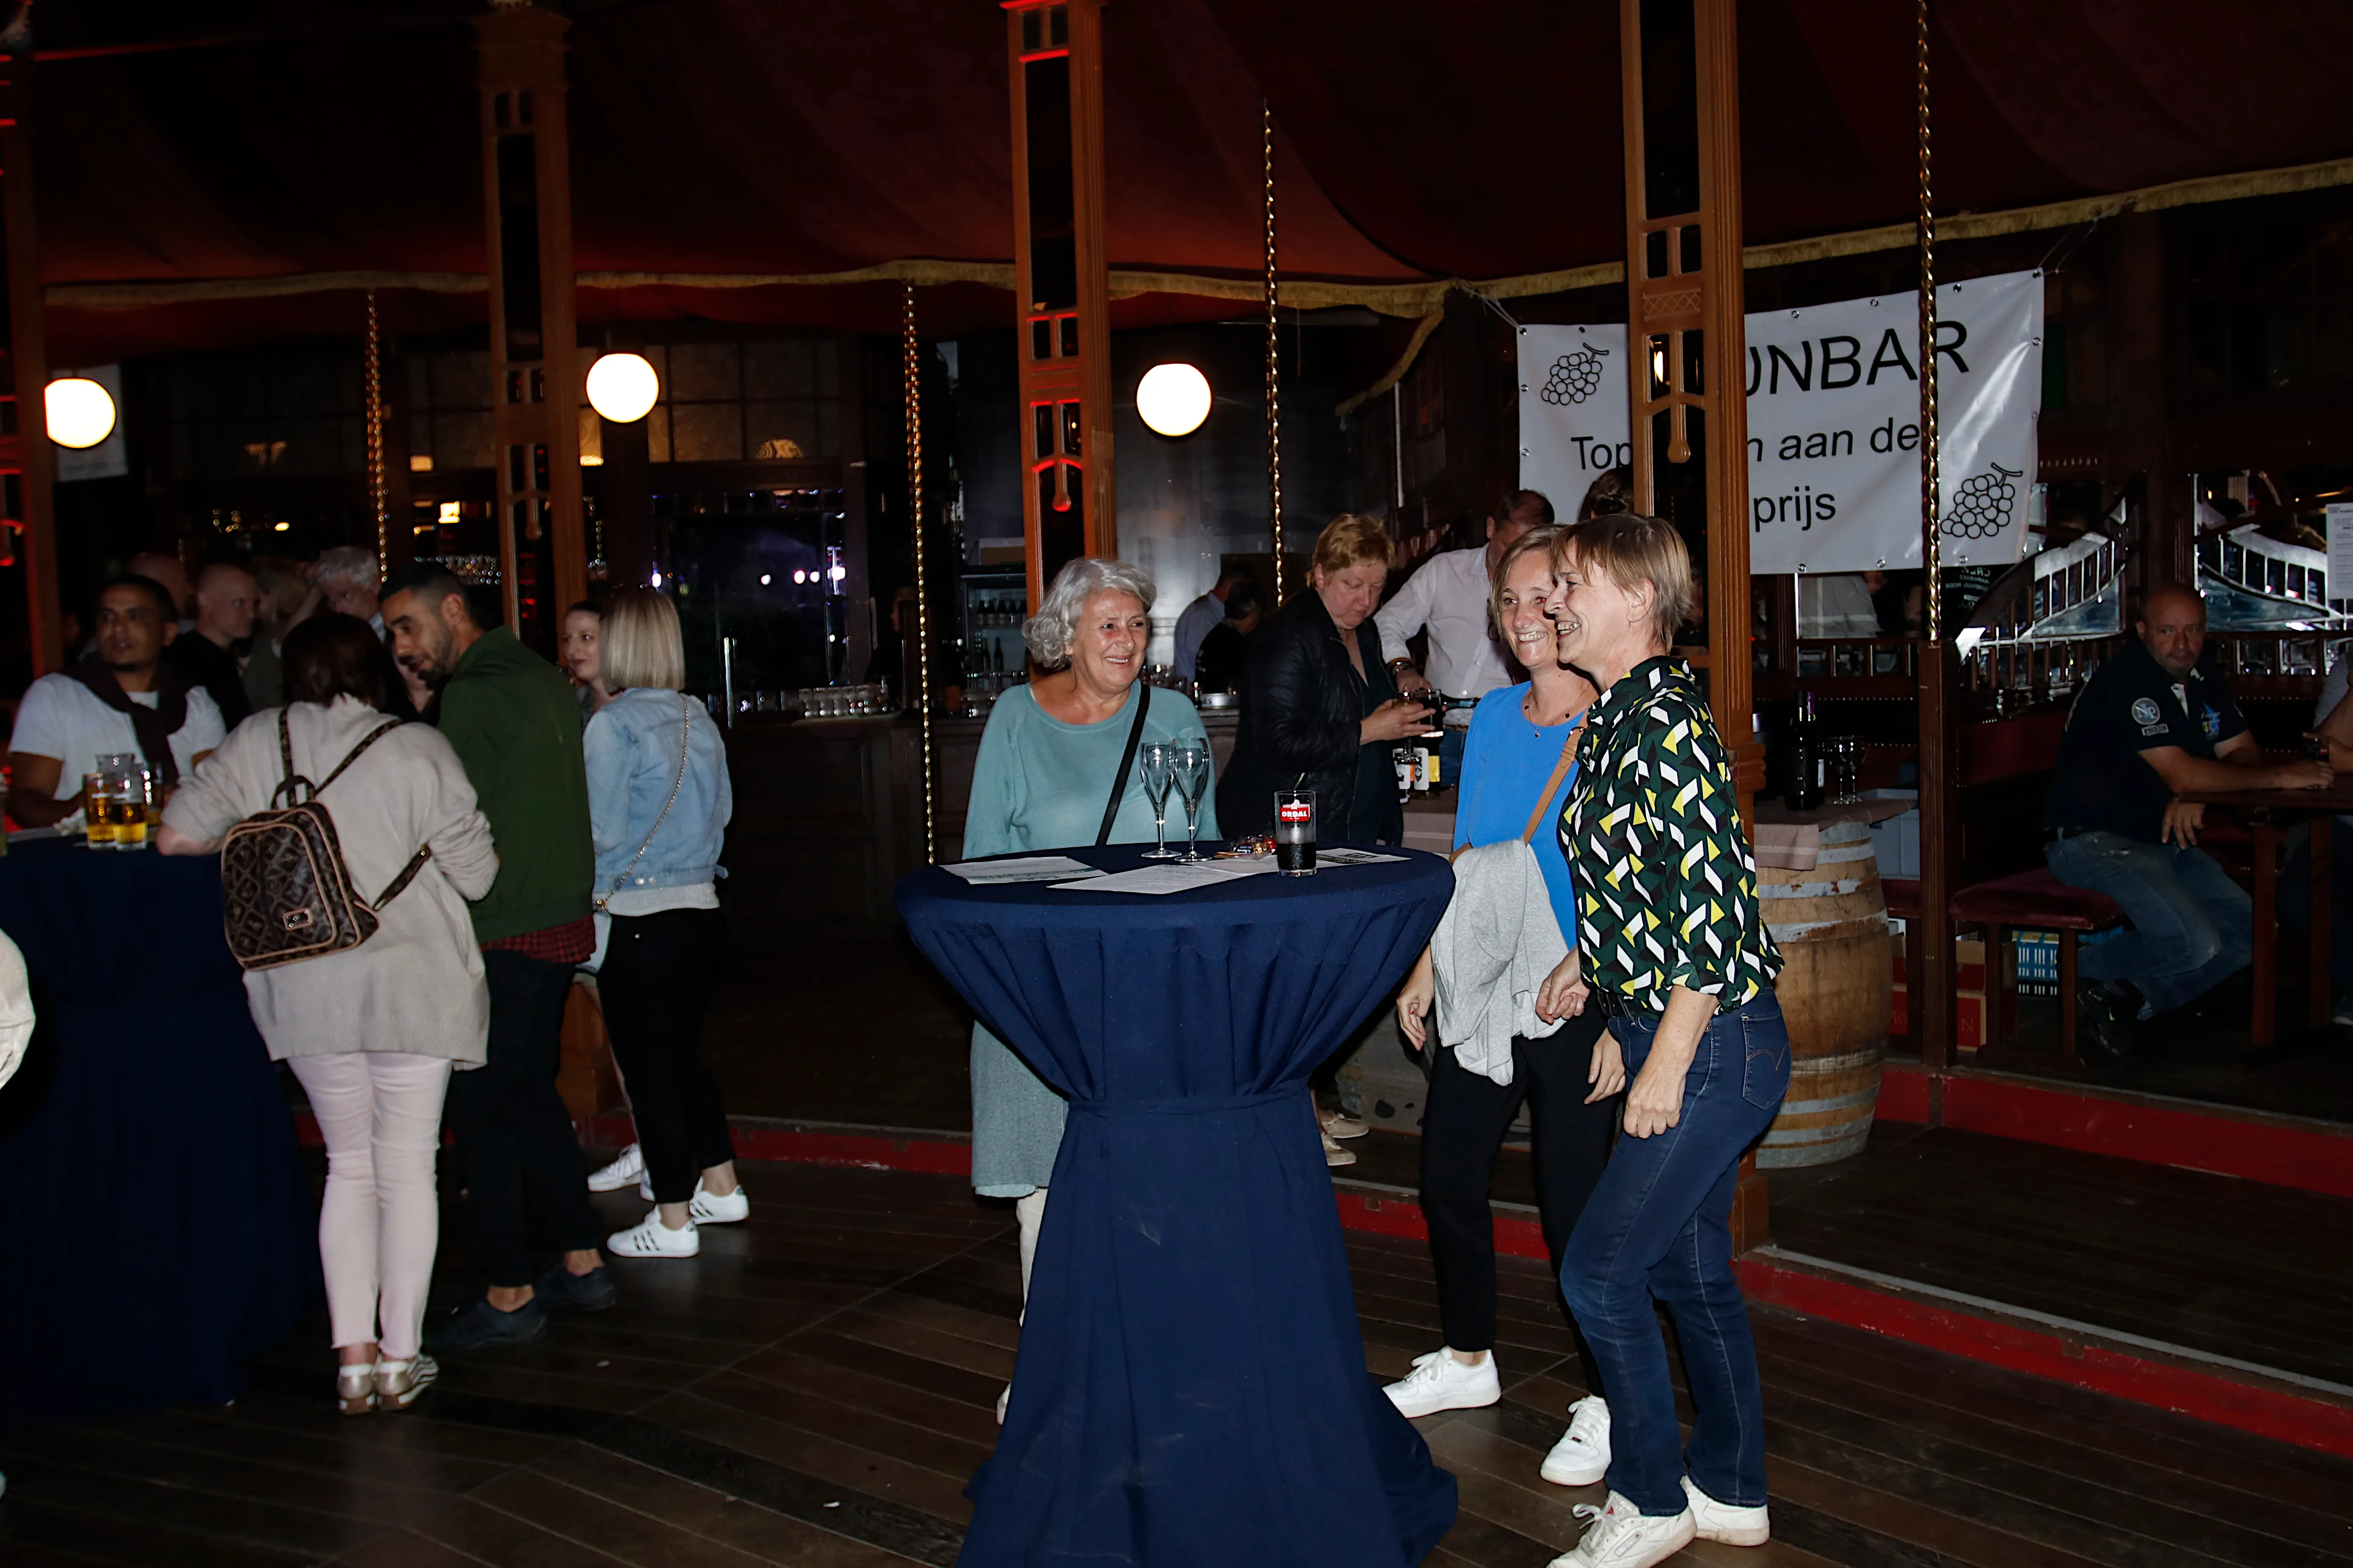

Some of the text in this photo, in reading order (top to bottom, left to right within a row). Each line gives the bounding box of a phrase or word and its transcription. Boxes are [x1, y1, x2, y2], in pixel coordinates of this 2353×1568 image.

[1746, 320, 1969, 397] JNBAR
[1779, 430, 1853, 460] aan
[1870, 417, 1920, 453] de
[1753, 486, 1836, 532] prijs
